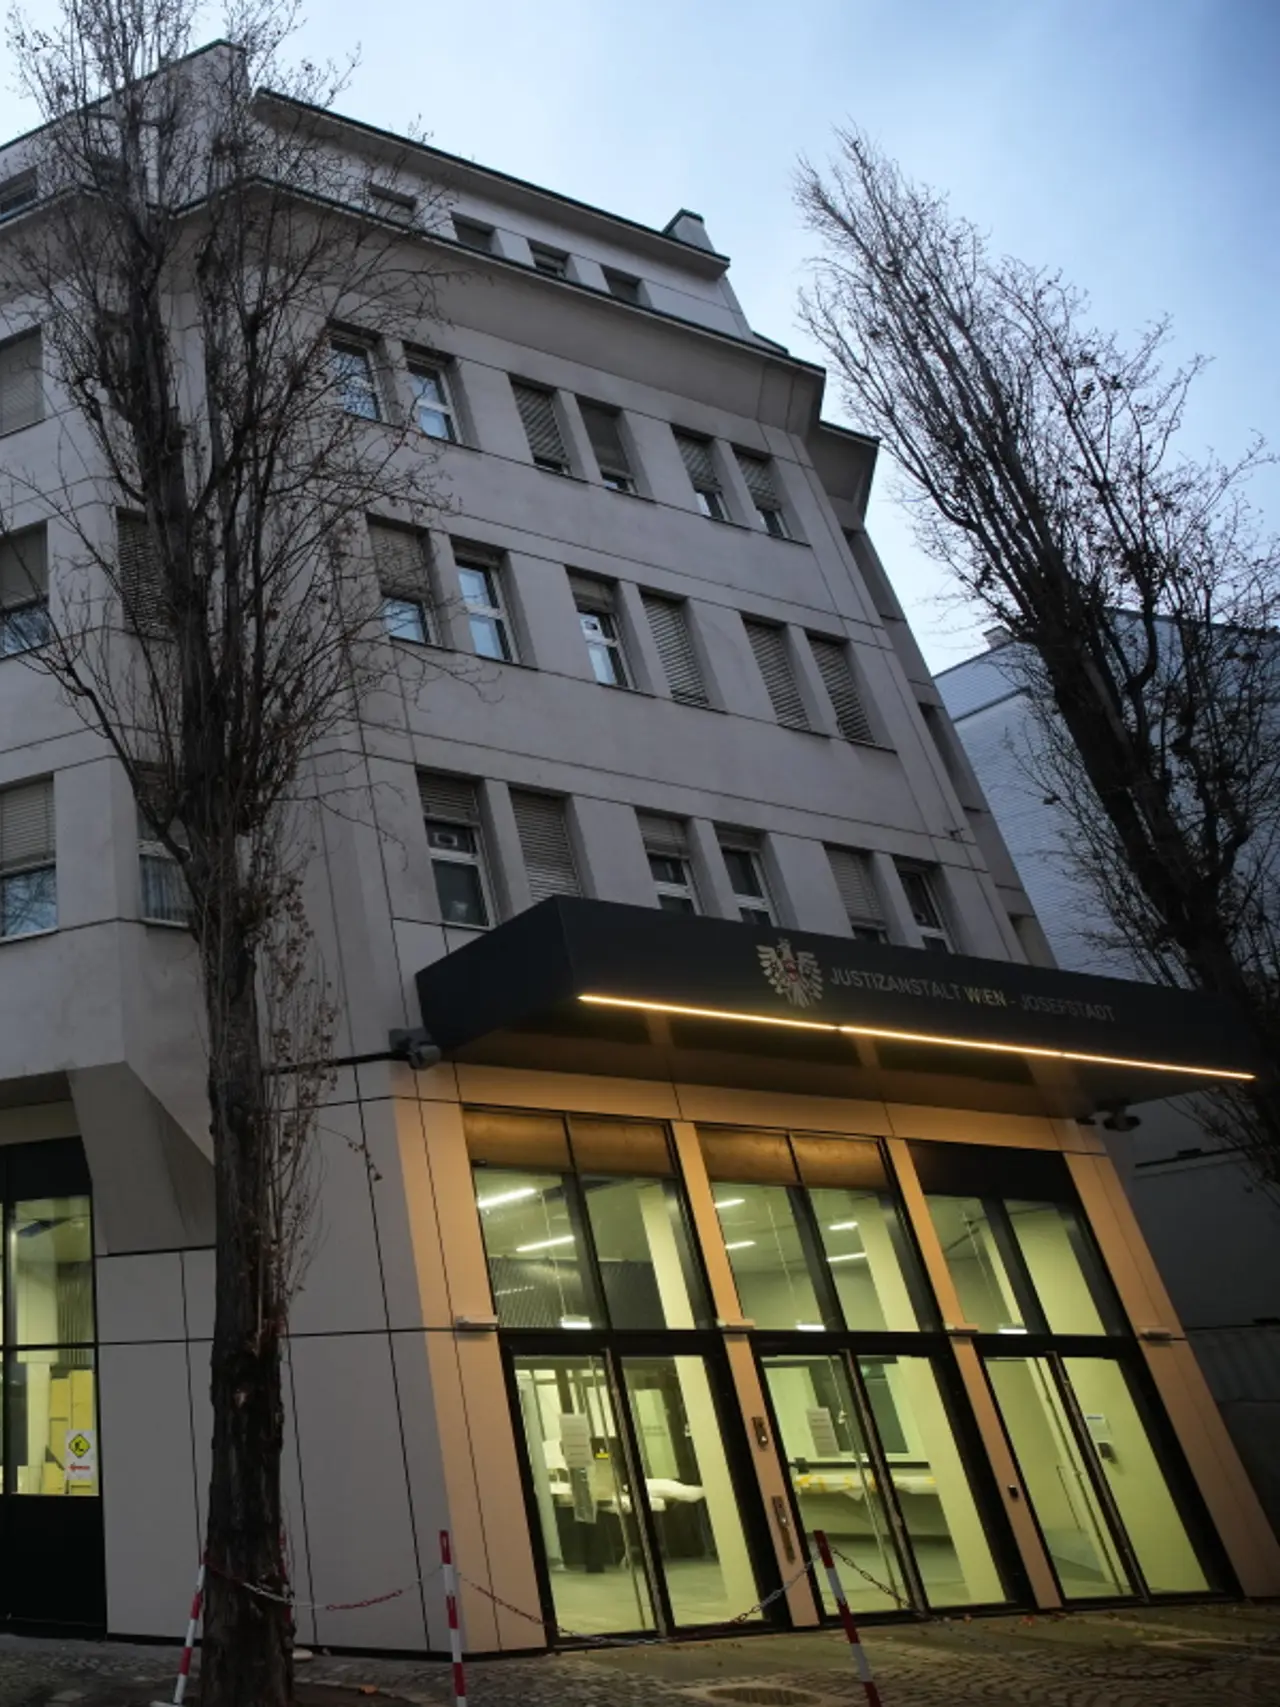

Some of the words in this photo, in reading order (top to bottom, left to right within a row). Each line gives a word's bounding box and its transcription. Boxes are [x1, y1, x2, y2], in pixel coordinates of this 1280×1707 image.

[830, 967, 962, 1000] JUSTIZANSTALT
[963, 985, 1006, 1008] WIEN
[1020, 993, 1115, 1022] JOSEFSTADT
